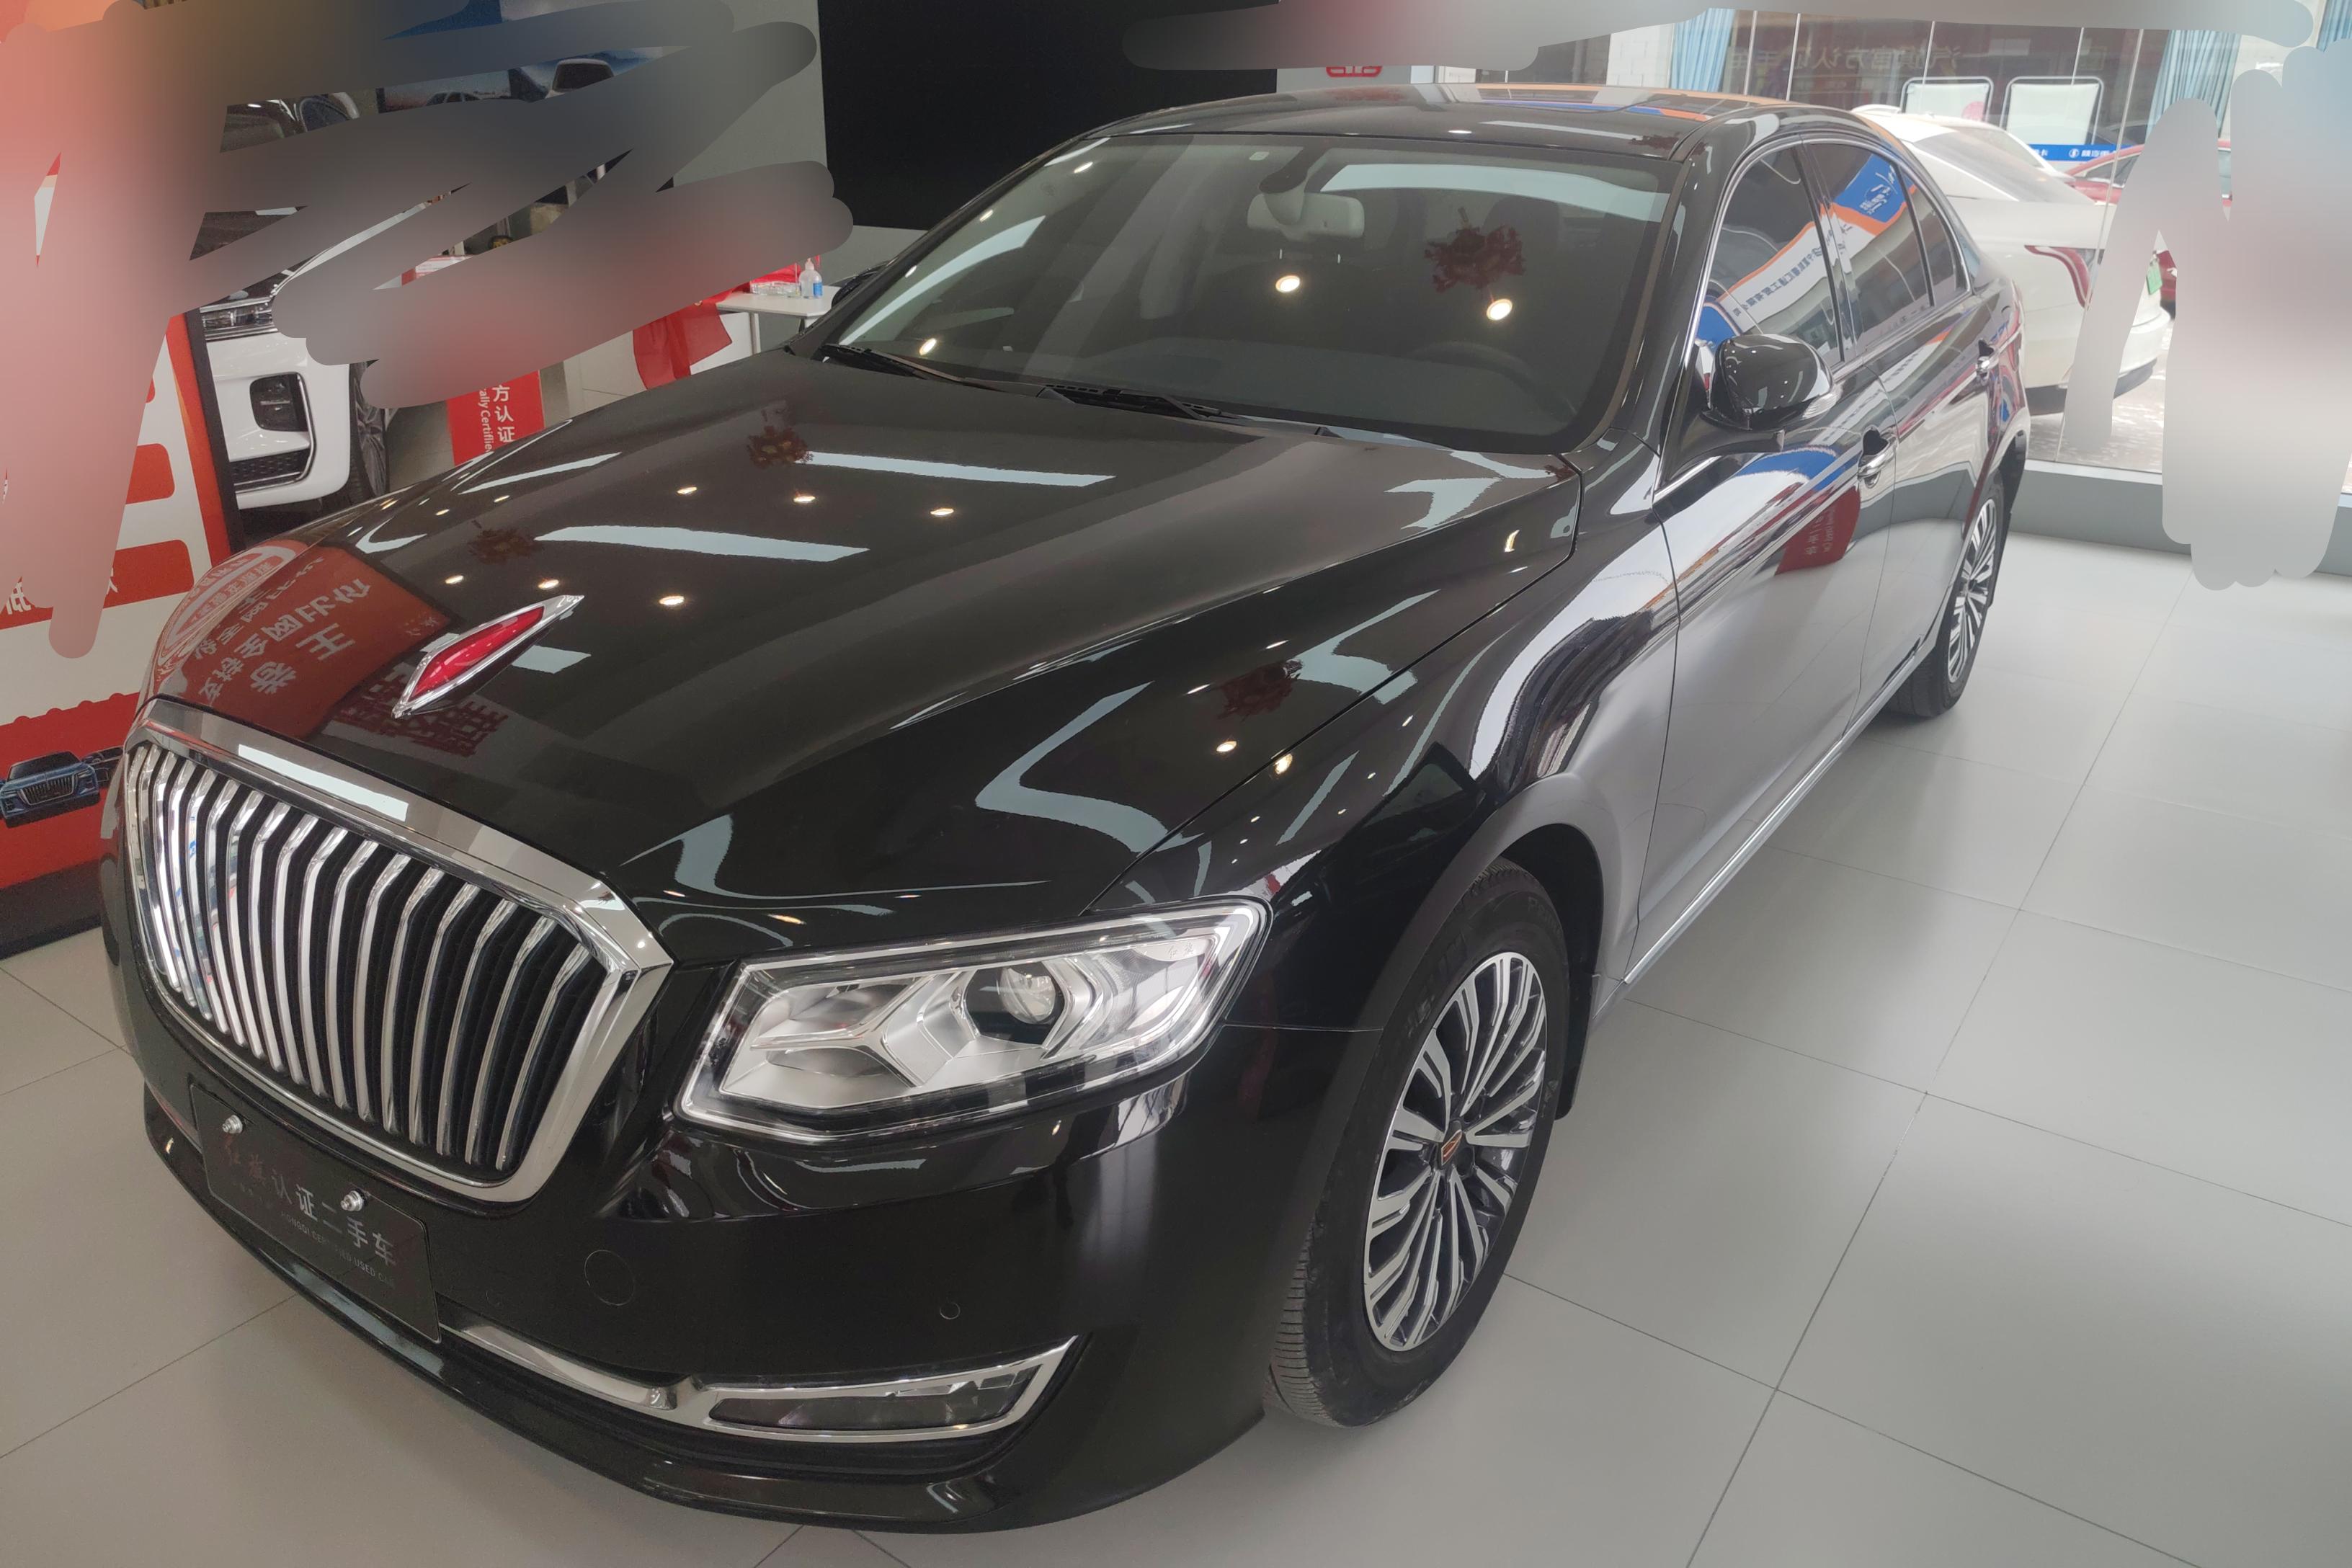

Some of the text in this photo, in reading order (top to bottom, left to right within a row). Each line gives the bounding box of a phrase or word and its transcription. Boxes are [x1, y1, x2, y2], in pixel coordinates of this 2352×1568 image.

[478, 388, 491, 409] ally
[492, 385, 516, 442] 方认证
